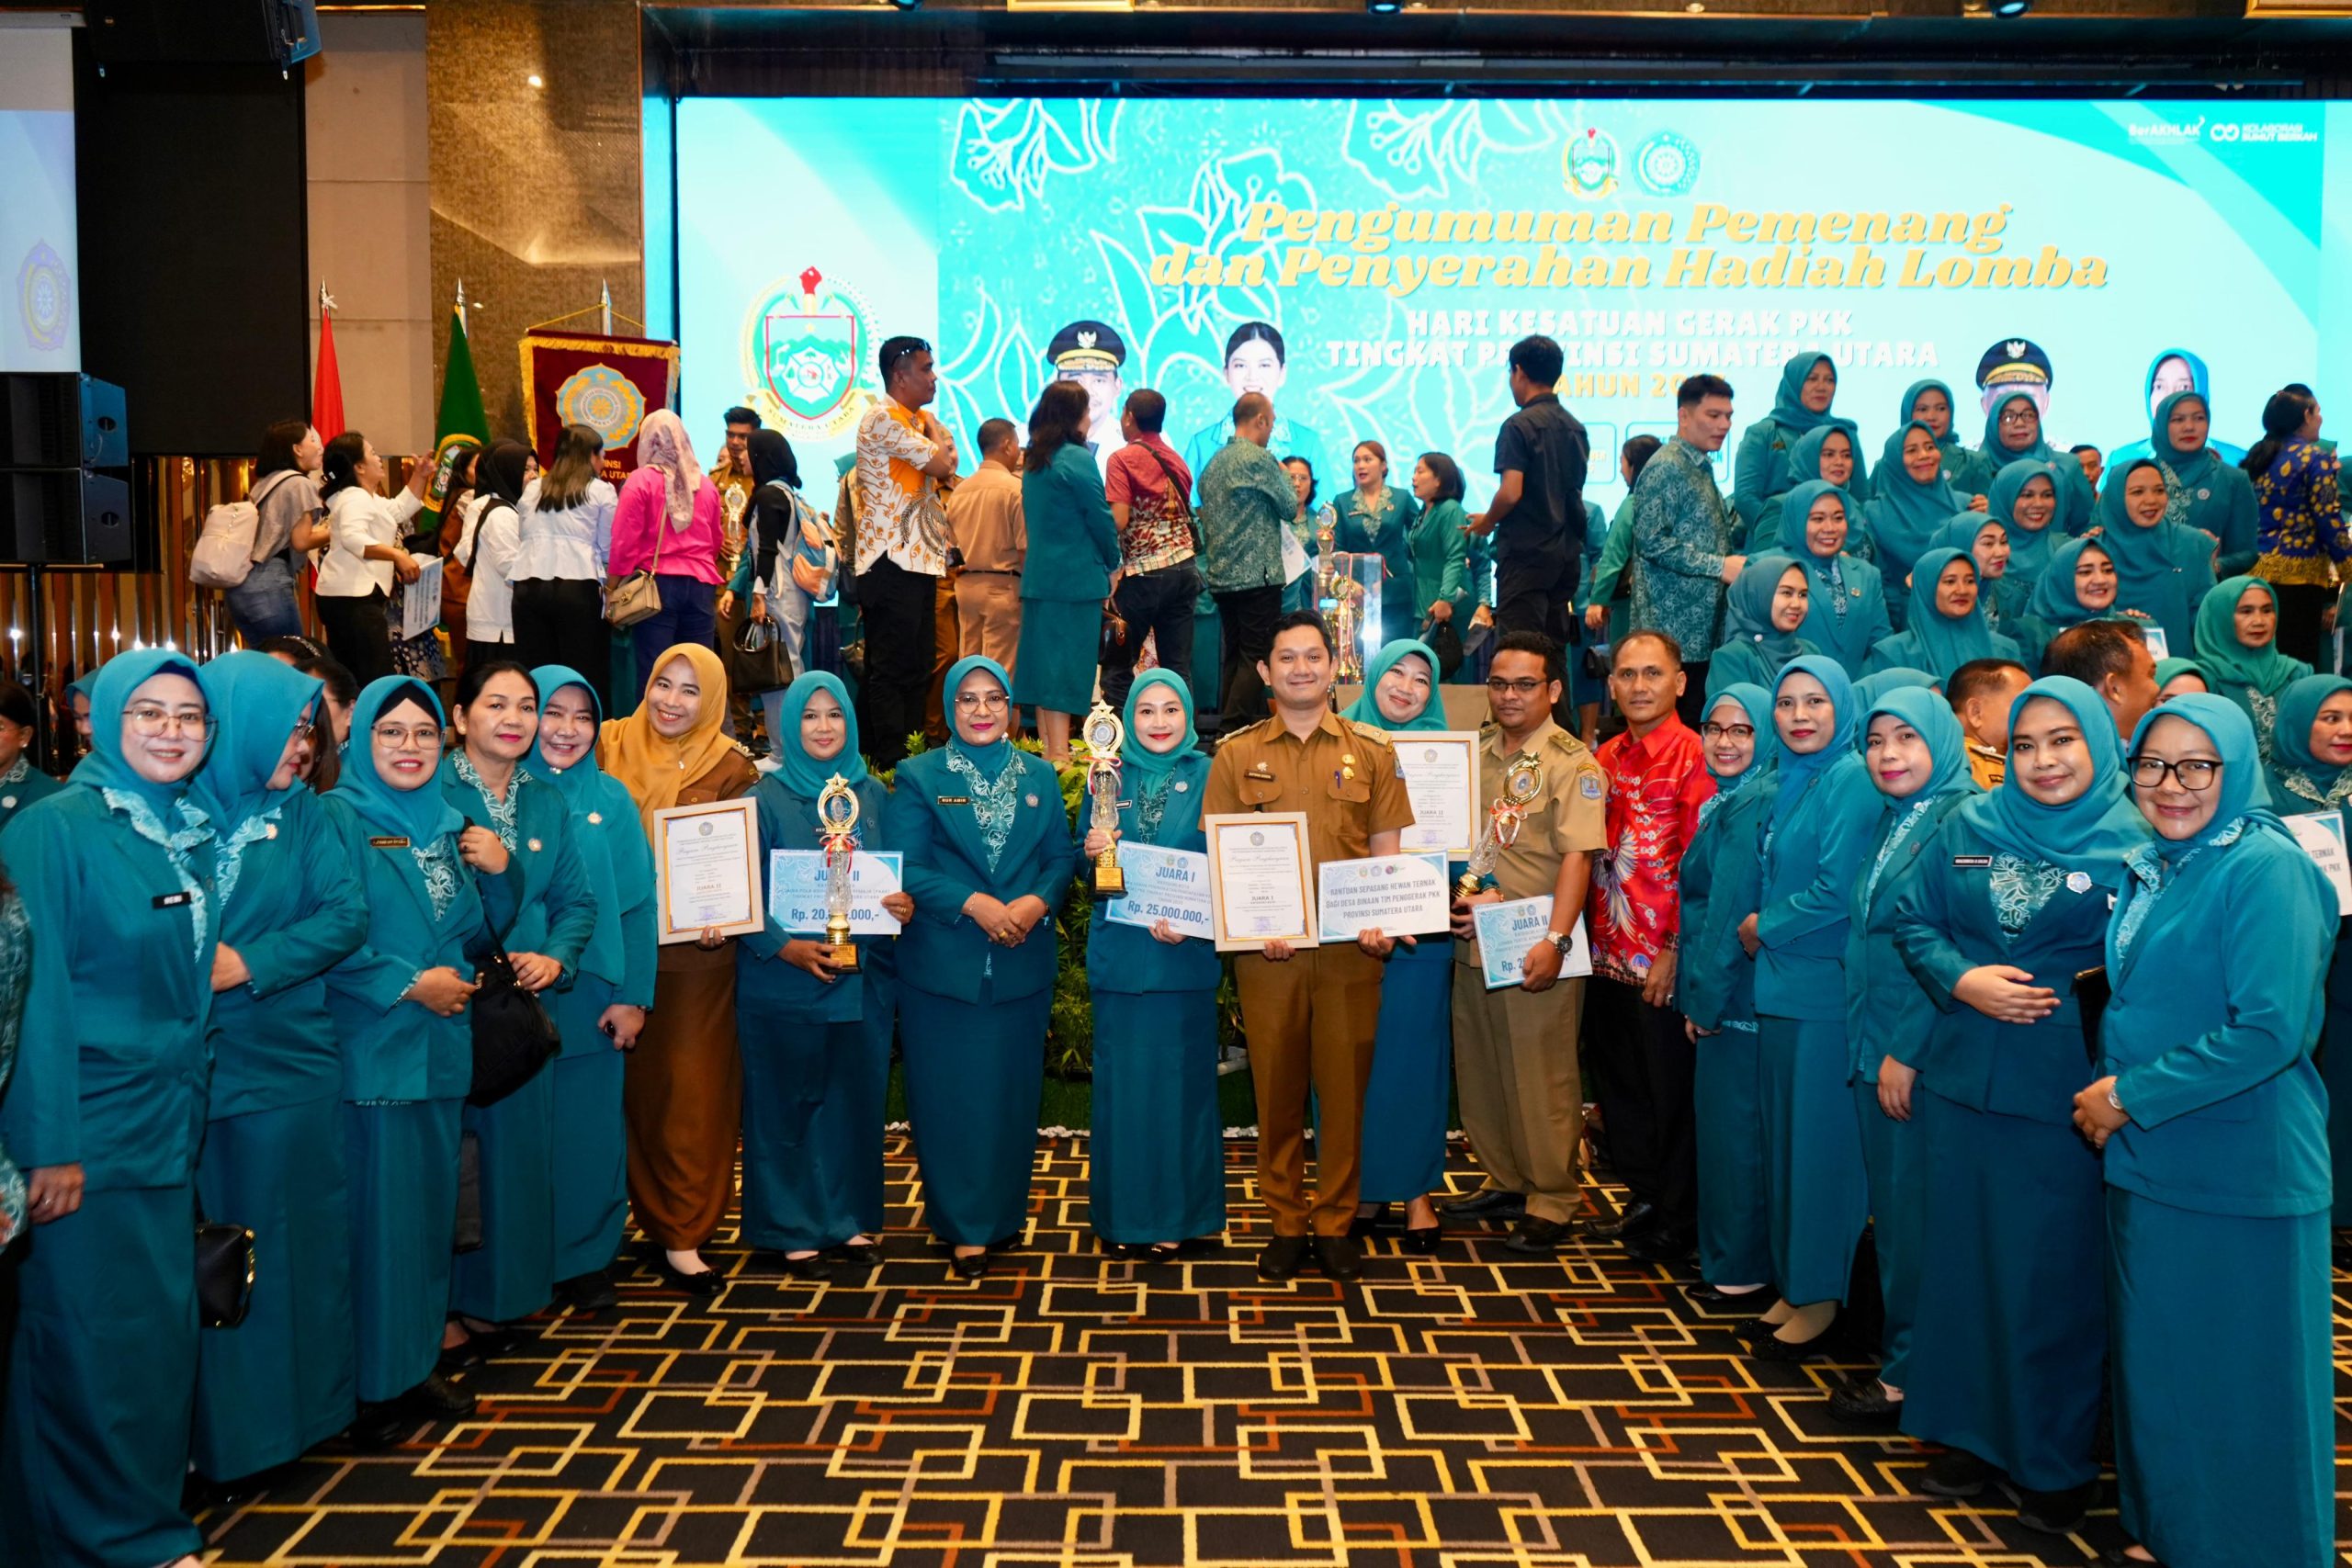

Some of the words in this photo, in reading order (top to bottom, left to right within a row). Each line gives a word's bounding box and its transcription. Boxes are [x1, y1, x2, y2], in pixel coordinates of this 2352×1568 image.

[1240, 201, 1673, 254] Pengumuman
[1683, 201, 2013, 254] Pemenang
[1148, 243, 1267, 288] dan
[1277, 243, 1652, 298] Penyerahan
[1661, 243, 1886, 289] Hadiah
[1895, 243, 2109, 289] Lomba
[1408, 309, 1491, 337] HARI
[1498, 309, 1668, 337] KESATUAN
[1675, 309, 1781, 337] GERAK
[1791, 309, 1853, 337] PKK
[1327, 340, 1472, 367] TINGKAT
[1832, 340, 1940, 367] UTARA
[1552, 372, 1640, 398] AHUN
[1650, 372, 1726, 398] 20
[1155, 866, 1188, 882] JUARA
[1191, 872, 1195, 882] I
[1330, 886, 1358, 896] BANTUAN
[1359, 884, 1389, 894] SEPASANG
[1390, 881, 1411, 890] HEWAN
[1412, 879, 1436, 888] TERNAK
[1326, 900, 1340, 908] BAGI
[1340, 898, 1356, 907] DESA
[1357, 897, 1380, 906] BINAAN
[1380, 896, 1391, 904] TIM
[1392, 893, 1426, 903] PENGGERAK
[1428, 891, 1441, 899] PKK
[791, 908, 808, 922] Rp.
[811, 908, 879, 921] 20..000,-
[1127, 900, 1143, 915] Rp.
[1146, 903, 1209, 925] 25.000.000,-
[1343, 910, 1371, 919] PROVINSI
[1372, 907, 1402, 917] SUMATERA
[1403, 904, 1423, 913] UTARA
[1512, 918, 1540, 931] JUARA
[1501, 960, 1516, 974] Rp.
